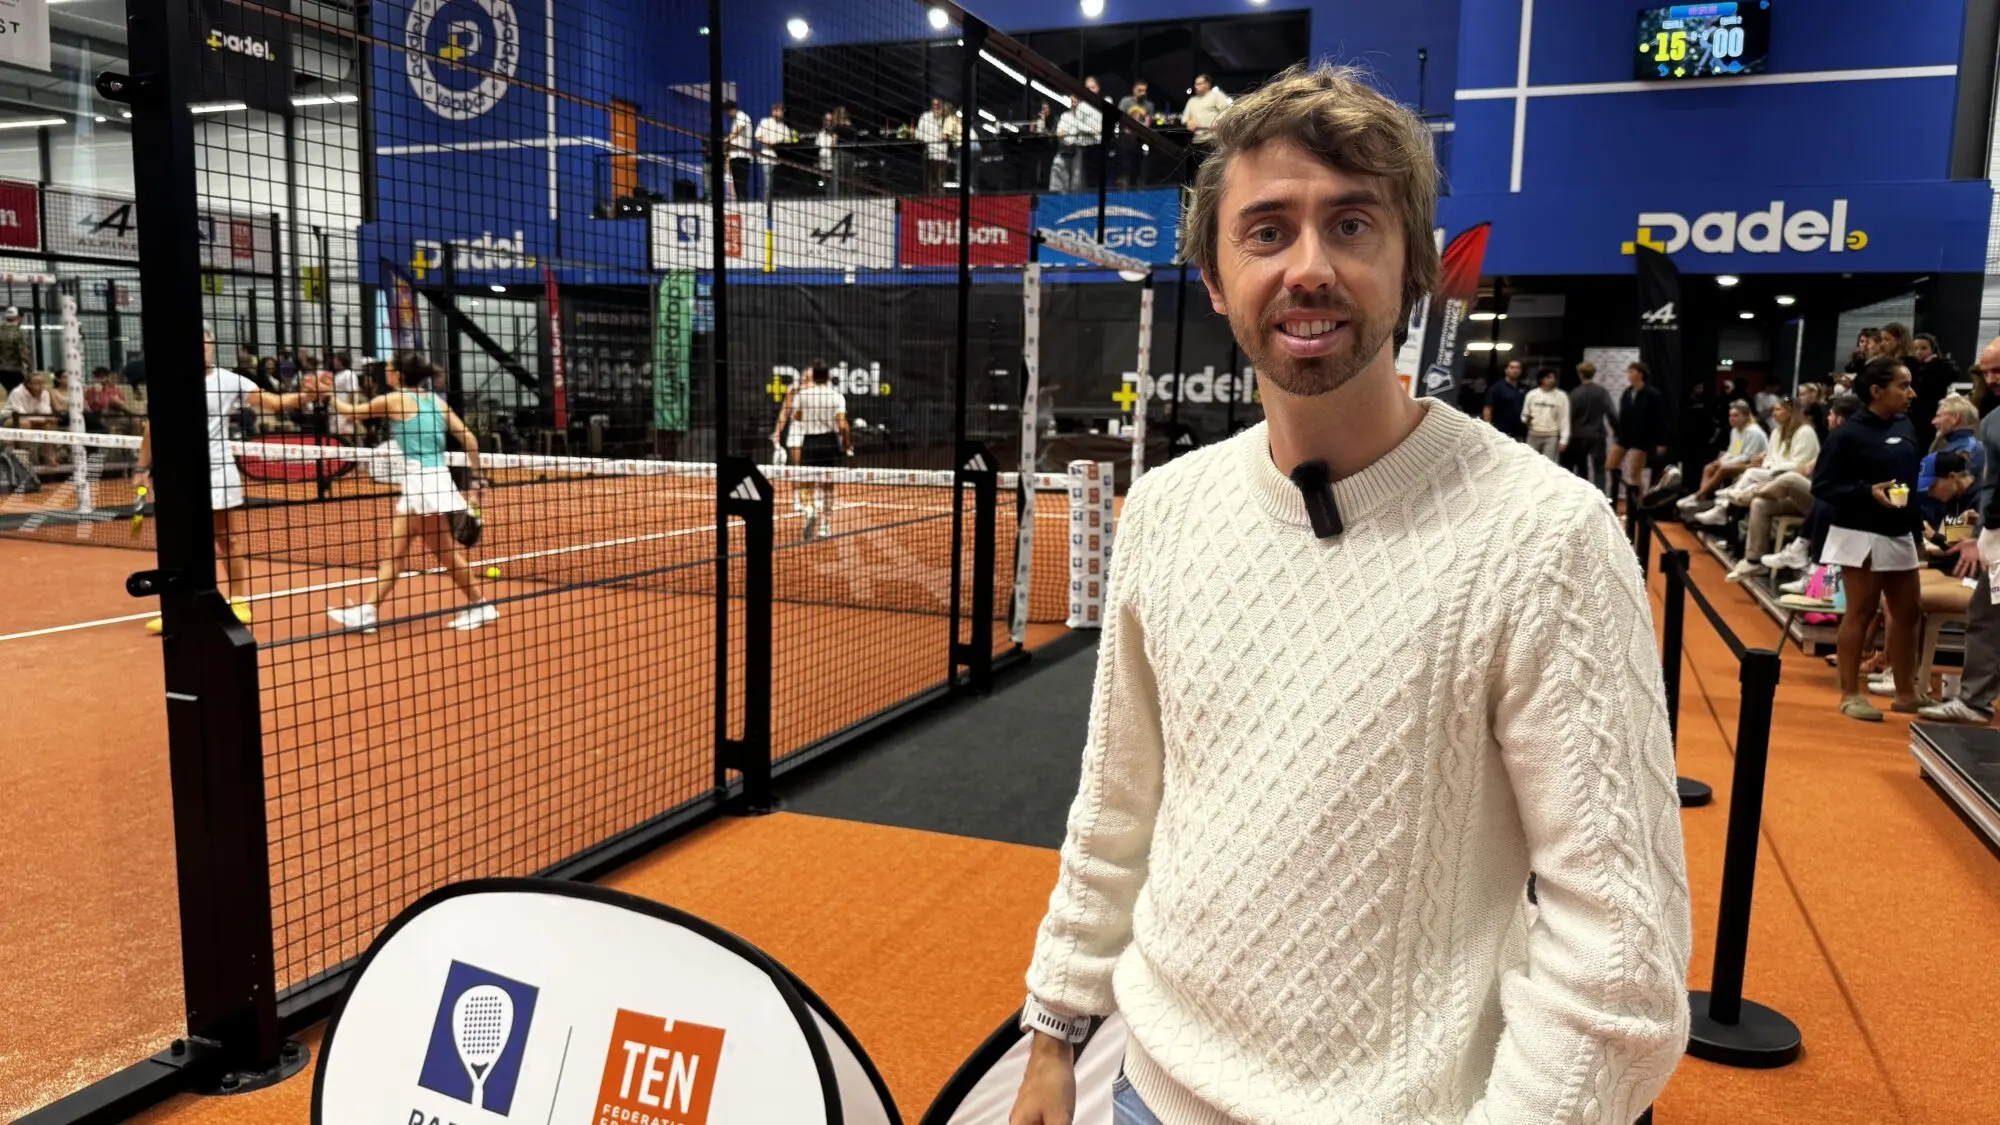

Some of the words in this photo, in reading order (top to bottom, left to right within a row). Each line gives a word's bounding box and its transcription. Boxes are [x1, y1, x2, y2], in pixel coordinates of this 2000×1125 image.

[1655, 31, 1687, 61] 15
[1712, 27, 1744, 58] 00
[619, 1039, 700, 1114] TEN
